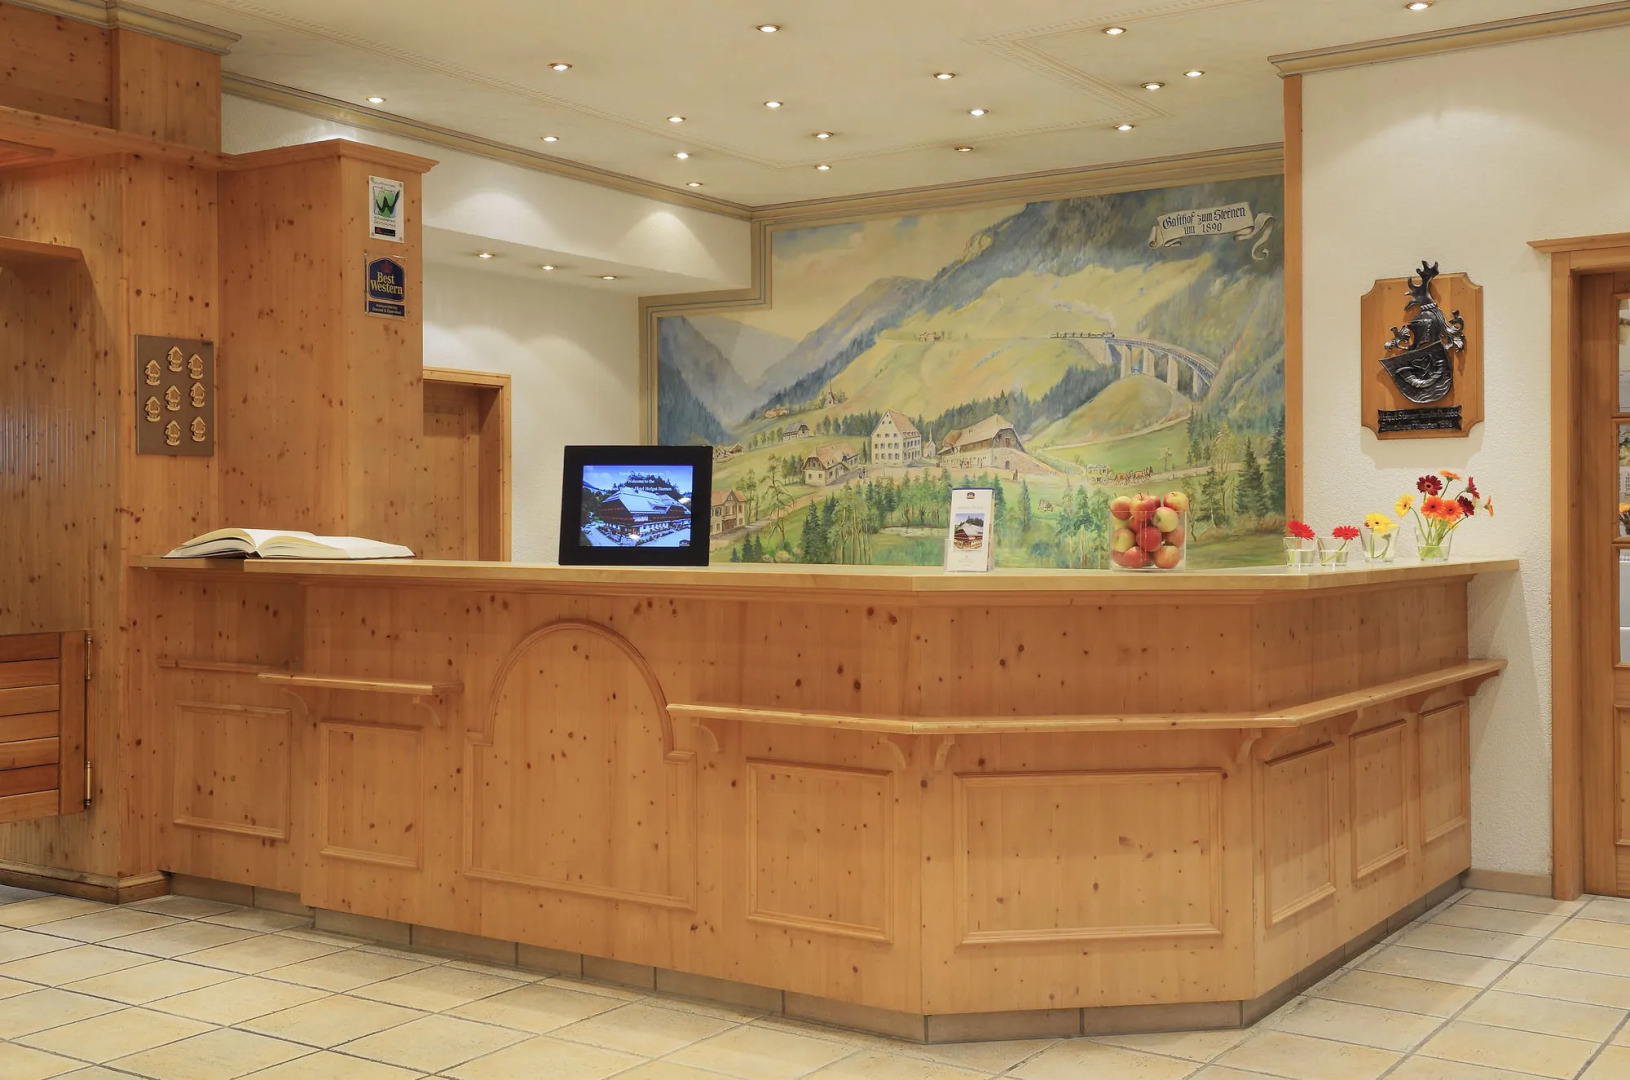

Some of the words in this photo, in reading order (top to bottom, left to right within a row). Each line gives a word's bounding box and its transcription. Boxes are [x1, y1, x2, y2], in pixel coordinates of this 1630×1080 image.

[1197, 213, 1213, 225] zum
[1213, 207, 1246, 222] Sternen
[1202, 222, 1222, 233] 1890
[377, 271, 395, 285] Best
[370, 279, 403, 295] Western
